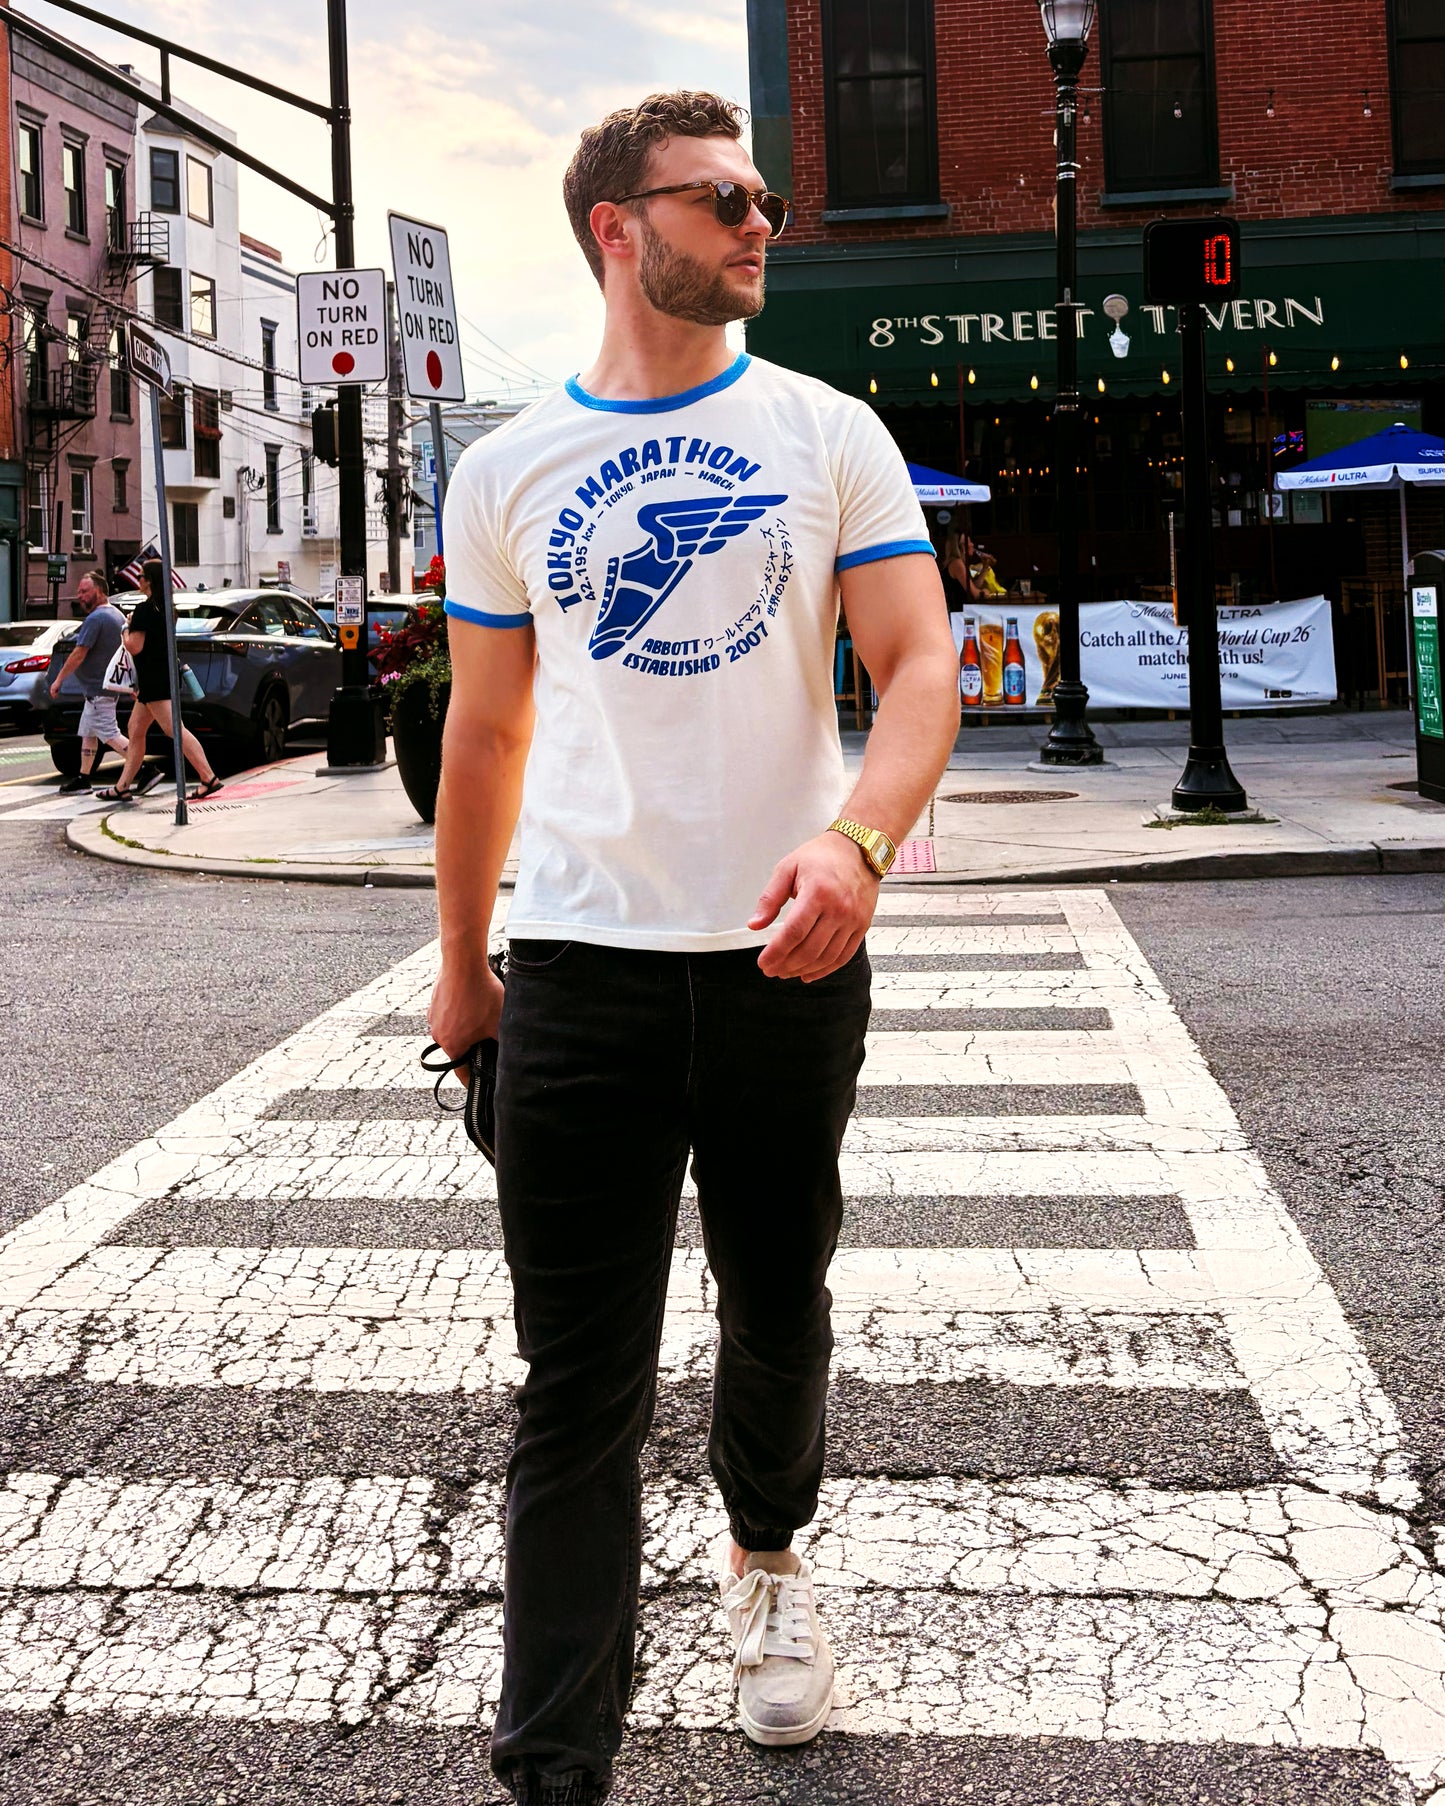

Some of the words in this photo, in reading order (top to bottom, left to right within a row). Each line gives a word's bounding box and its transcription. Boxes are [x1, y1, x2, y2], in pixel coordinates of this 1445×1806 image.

[407, 231, 434, 269] NO
[1204, 234, 1231, 285] 10
[322, 278, 360, 300] NO
[407, 275, 445, 308] TURN
[316, 305, 367, 324] TURN
[1139, 296, 1324, 334] TVERN
[306, 330, 333, 348] ON
[342, 328, 378, 346] RED
[404, 312, 424, 340] ON
[429, 316, 454, 345] RED
[135, 339, 150, 365] ONE
[1338, 471, 1368, 481] ULTRA
[945, 488, 971, 496] ULTRA
[547, 507, 584, 614] TOKYO
[574, 436, 762, 509] MARATHON
[575, 545, 597, 601] 42.195
[640, 467, 676, 485] JAPAN
[697, 470, 736, 491] MARCH
[1216, 608, 1262, 620] LTRA
[622, 652, 721, 676] ESTABLISHED
[725, 620, 769, 663] 2007
[641, 638, 700, 656] ABBOTT
[1080, 630, 1124, 648] Catch
[1127, 630, 1146, 647] all
[1149, 630, 1174, 646] the
[1217, 629, 1258, 646] World
[1260, 627, 1291, 648] Cup
[1217, 648, 1239, 665] ith
[1242, 648, 1264, 664] us!
[1161, 672, 1187, 680] JUNE
